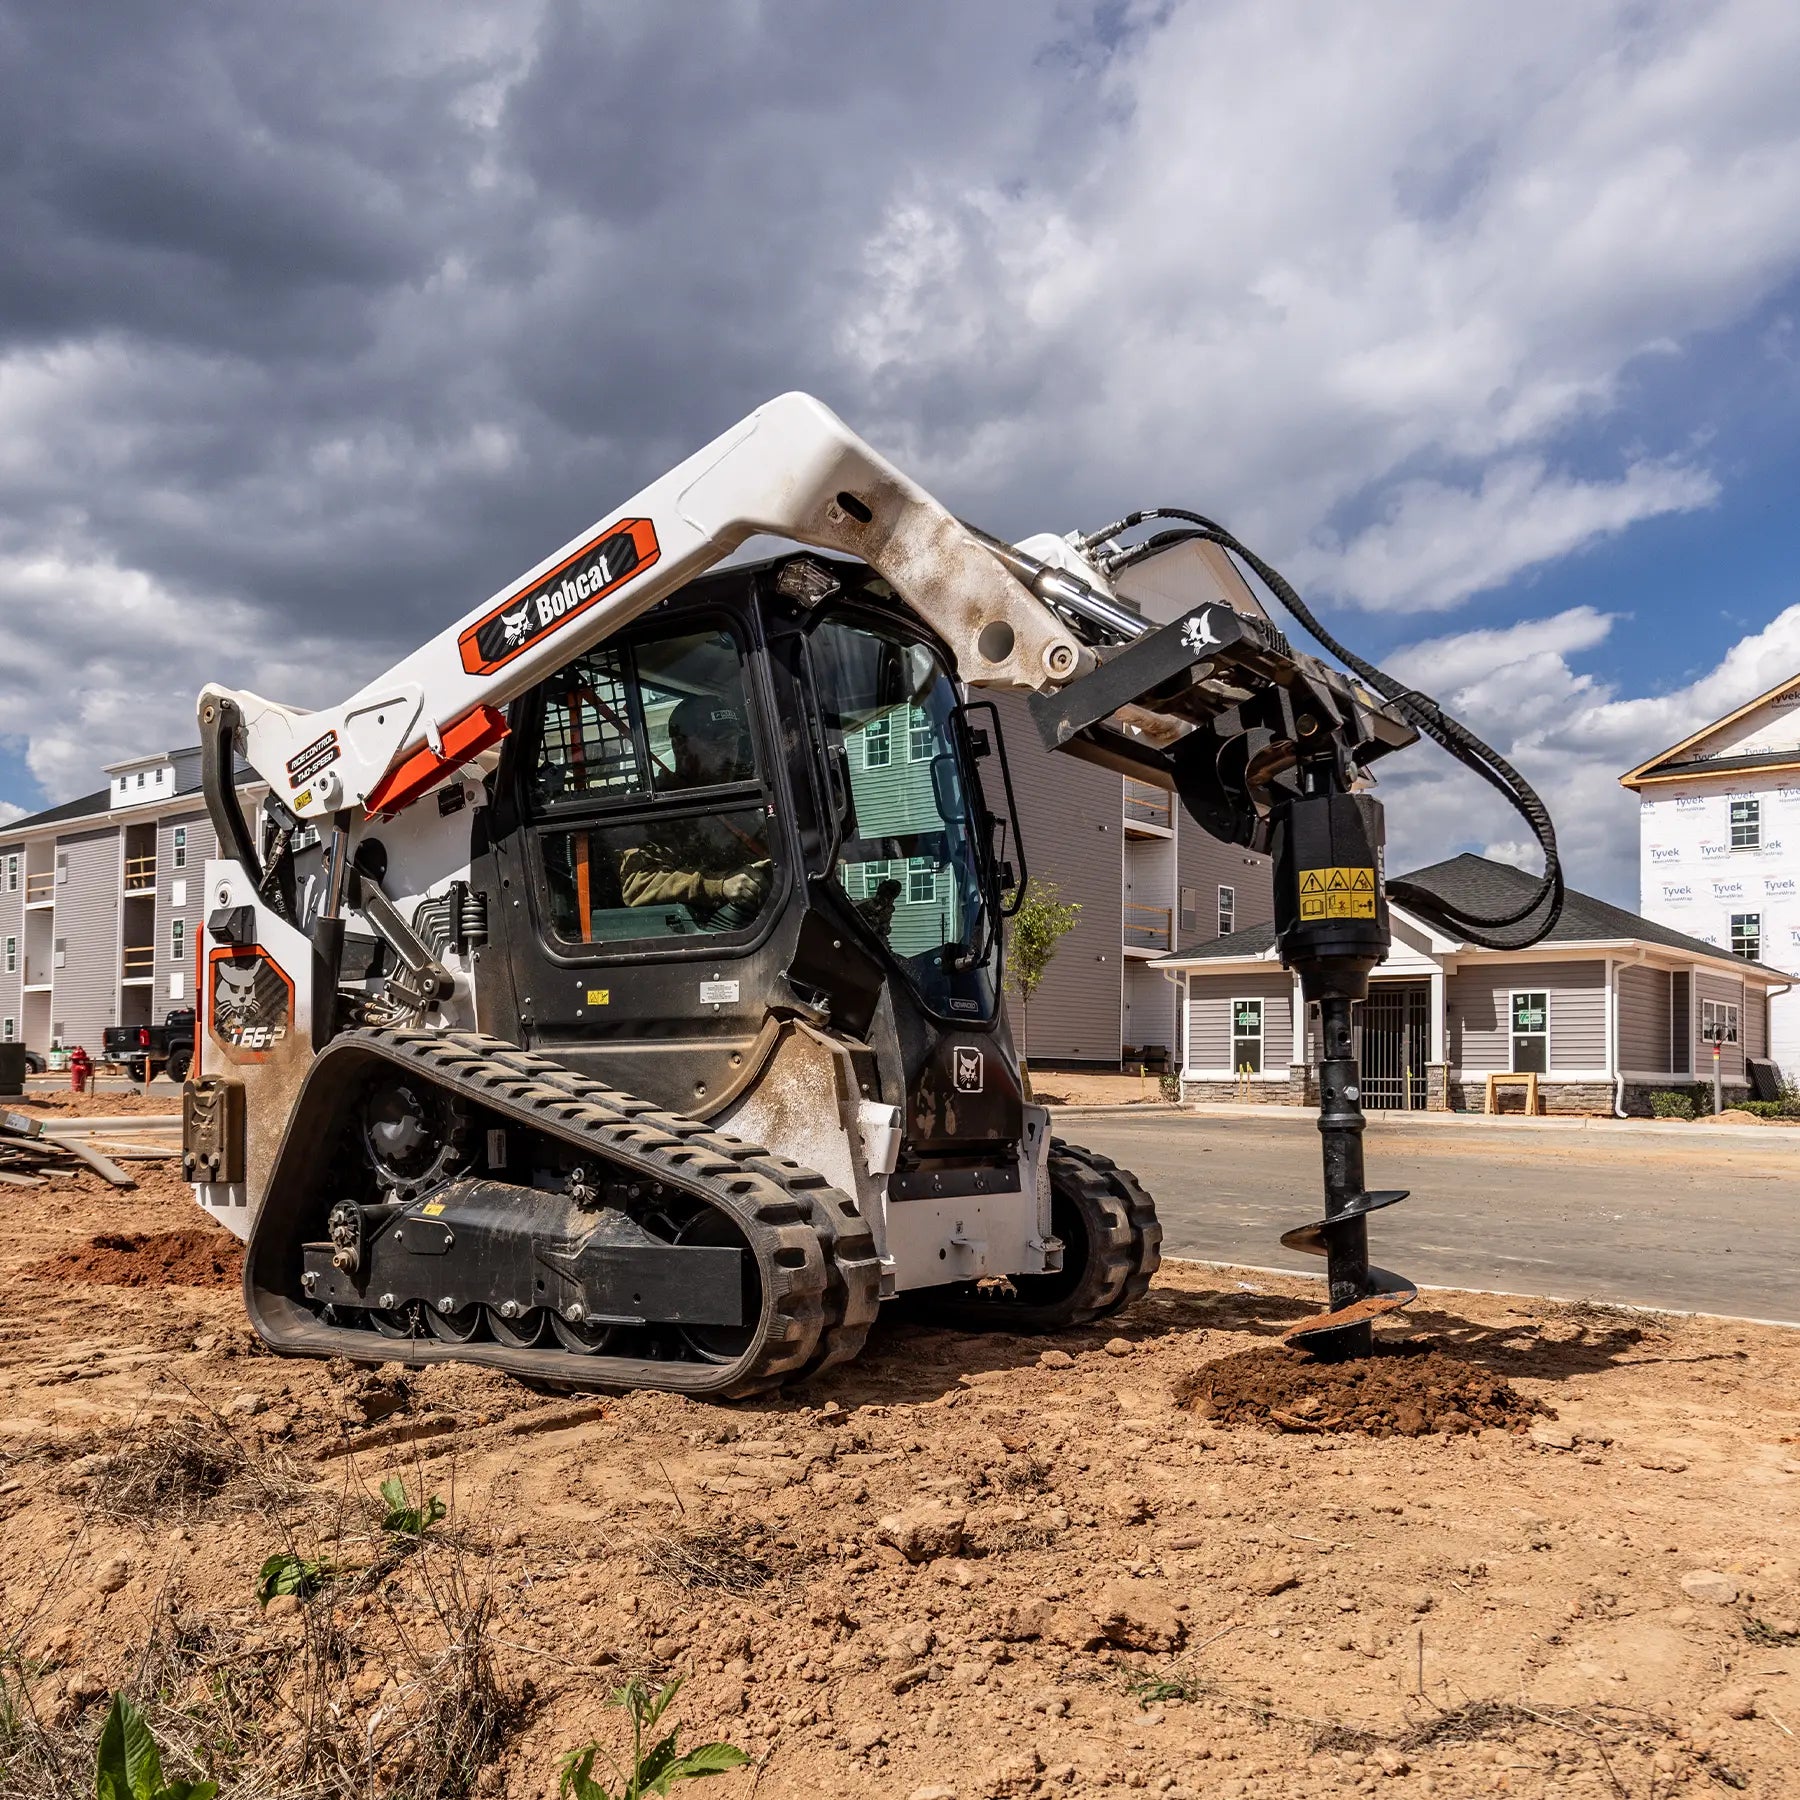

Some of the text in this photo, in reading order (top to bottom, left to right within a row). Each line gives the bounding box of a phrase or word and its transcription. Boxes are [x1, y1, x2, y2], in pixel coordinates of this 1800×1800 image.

[536, 554, 612, 627] Bobcat
[291, 734, 334, 770] RIDE CONTROL
[298, 751, 334, 782] TWO-SPEED
[1675, 795, 1704, 807] Tyvek
[1651, 848, 1679, 859] Tyvek
[1663, 886, 1691, 897] Tyvek
[1713, 882, 1742, 894] Tyvek
[1765, 880, 1795, 891] Tyvek
